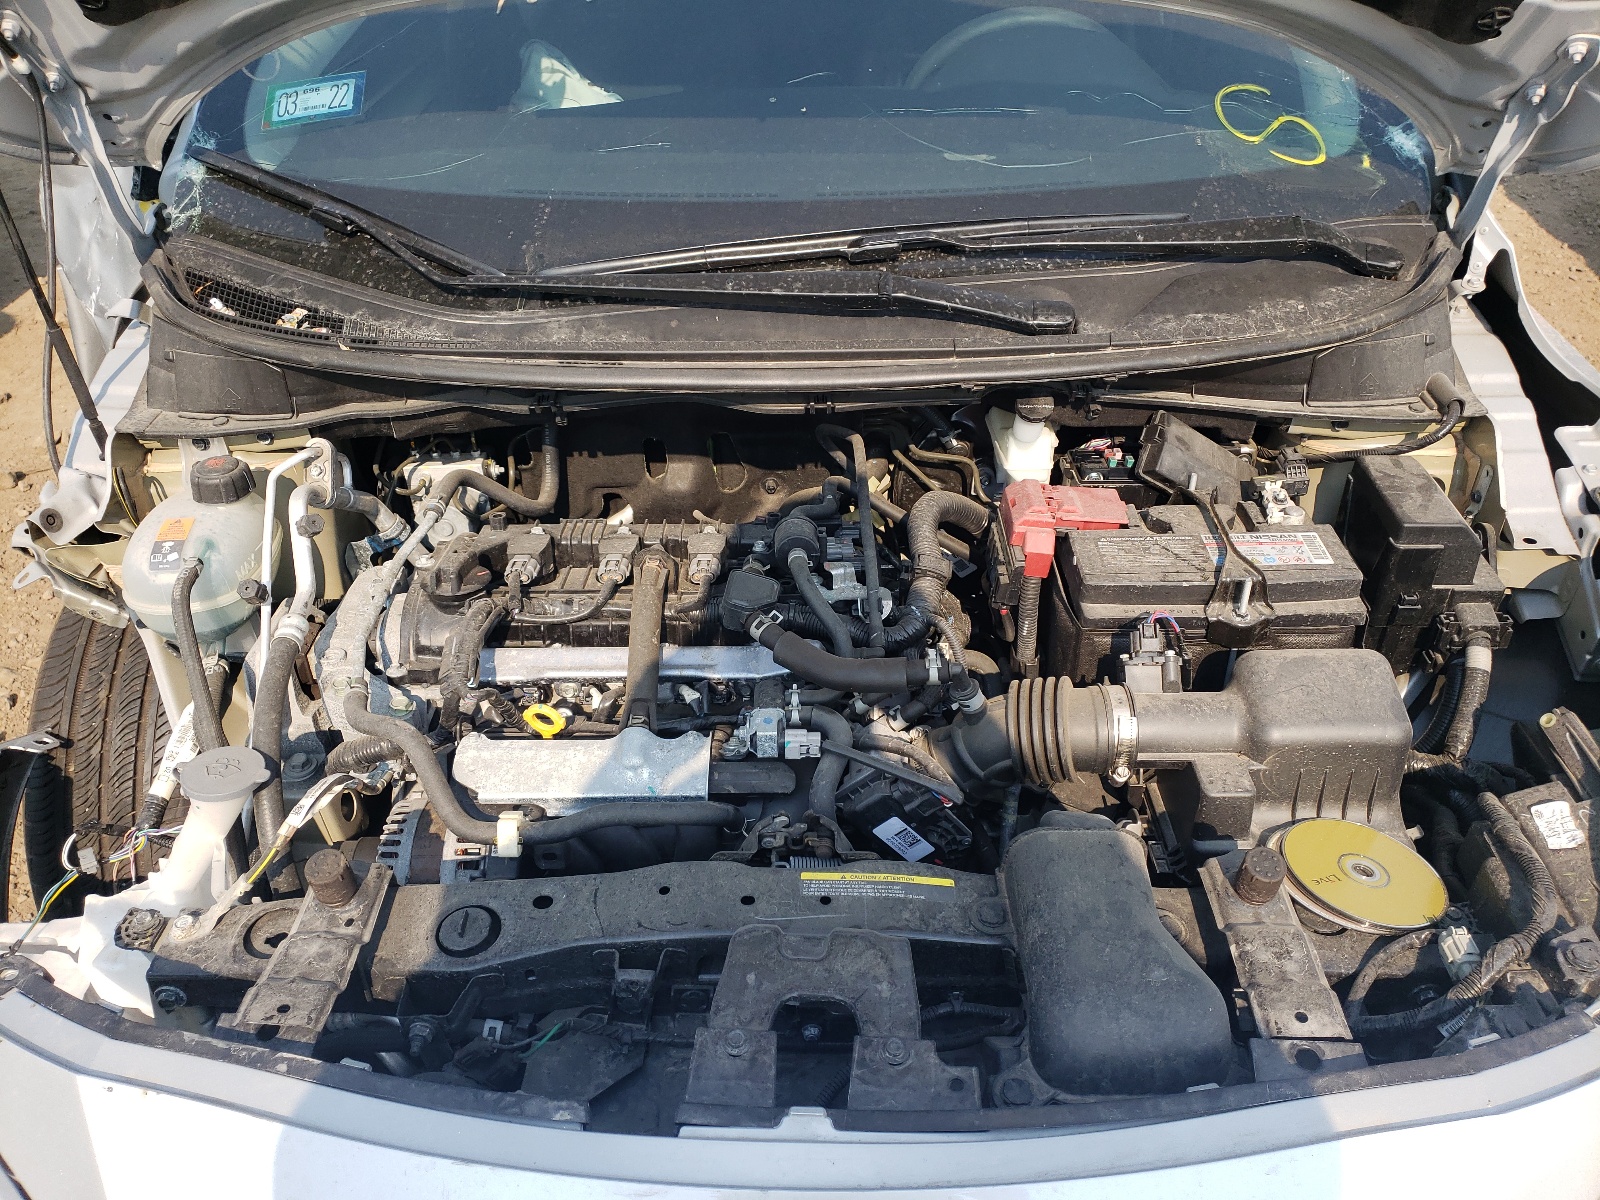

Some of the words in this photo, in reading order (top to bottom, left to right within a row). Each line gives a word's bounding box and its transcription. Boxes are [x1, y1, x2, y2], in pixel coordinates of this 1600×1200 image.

[277, 90, 299, 118] 03
[328, 82, 350, 110] 22
[302, 86, 321, 95] 696
